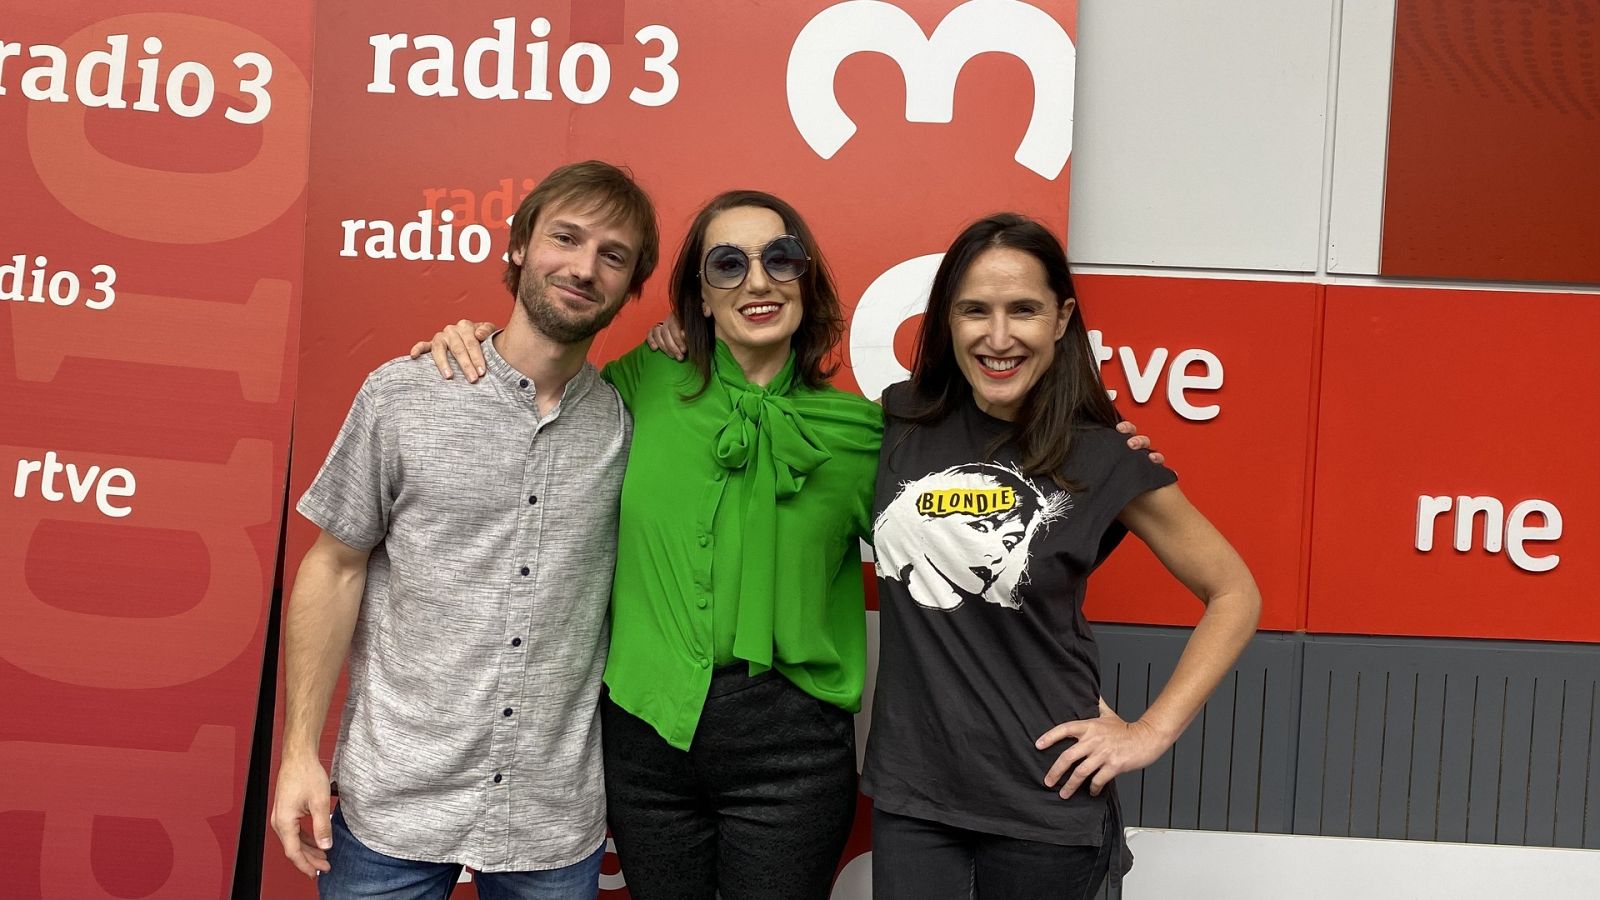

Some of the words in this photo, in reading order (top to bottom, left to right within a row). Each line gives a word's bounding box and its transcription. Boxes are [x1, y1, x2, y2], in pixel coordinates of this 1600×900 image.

[224, 51, 273, 124] 3
[367, 16, 611, 105] radio
[629, 24, 680, 107] 3
[340, 209, 492, 264] radio
[85, 264, 117, 310] 3
[14, 451, 136, 518] rtve
[921, 489, 1011, 514] BLONDIE
[1415, 494, 1563, 572] rne
